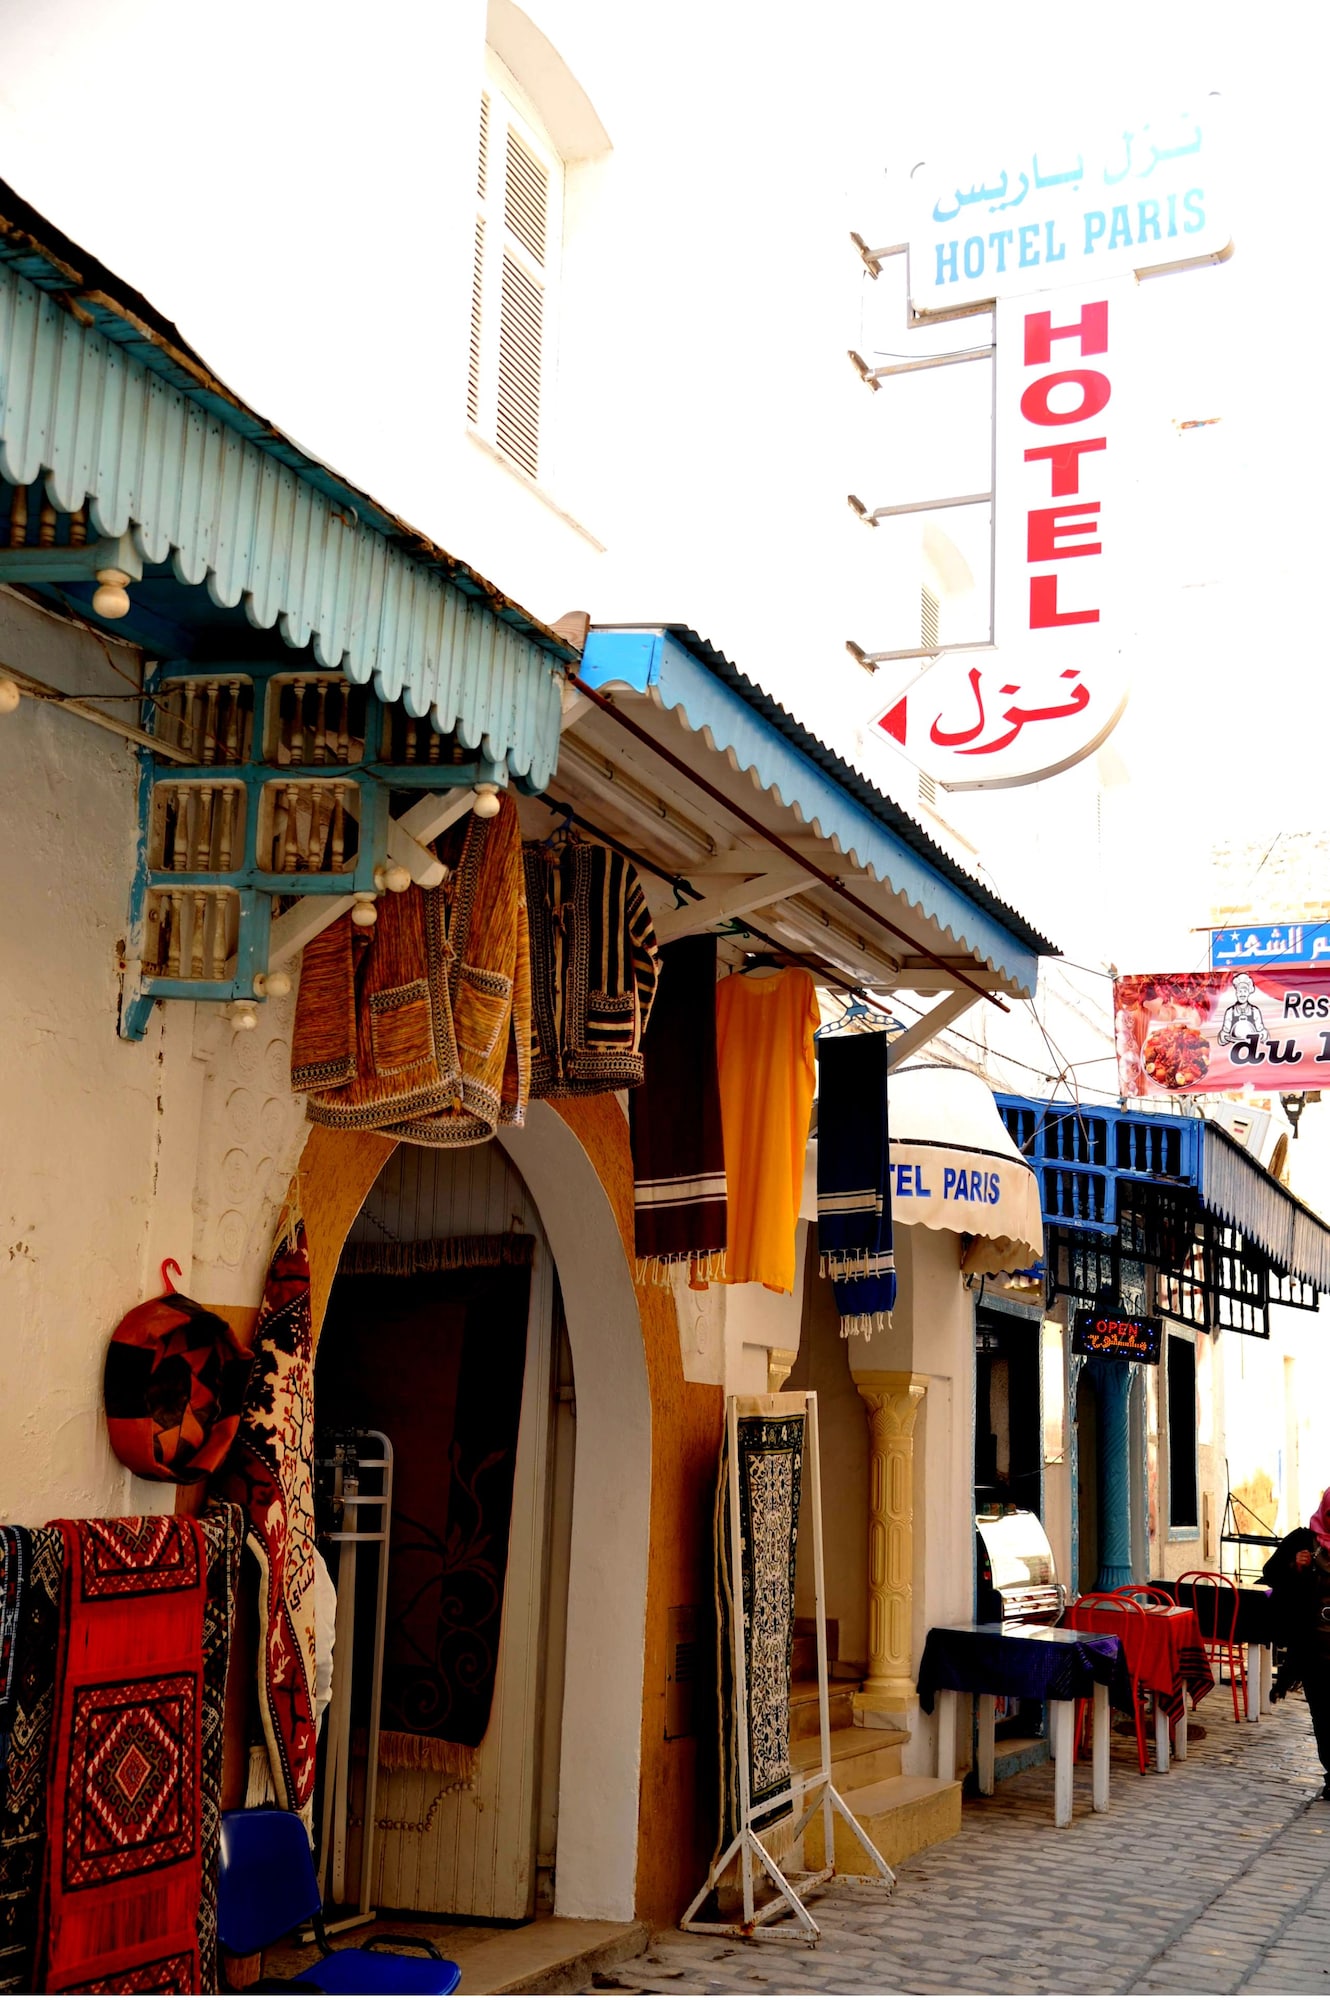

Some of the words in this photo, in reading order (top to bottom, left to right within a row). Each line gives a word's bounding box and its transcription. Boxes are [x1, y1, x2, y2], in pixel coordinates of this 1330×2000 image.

[1102, 111, 1205, 187] نزل
[930, 151, 1085, 223] باريس
[934, 219, 1067, 286] HOTEL
[1083, 186, 1207, 256] PARIS
[1021, 300, 1111, 630] HOTEL
[929, 668, 1091, 755] نزل
[1216, 926, 1303, 965] الشعب
[1283, 992, 1329, 1018] Res
[1230, 1033, 1302, 1065] du
[943, 1167, 1000, 1205] PARIS
[1096, 1320, 1139, 1337] OPEN
